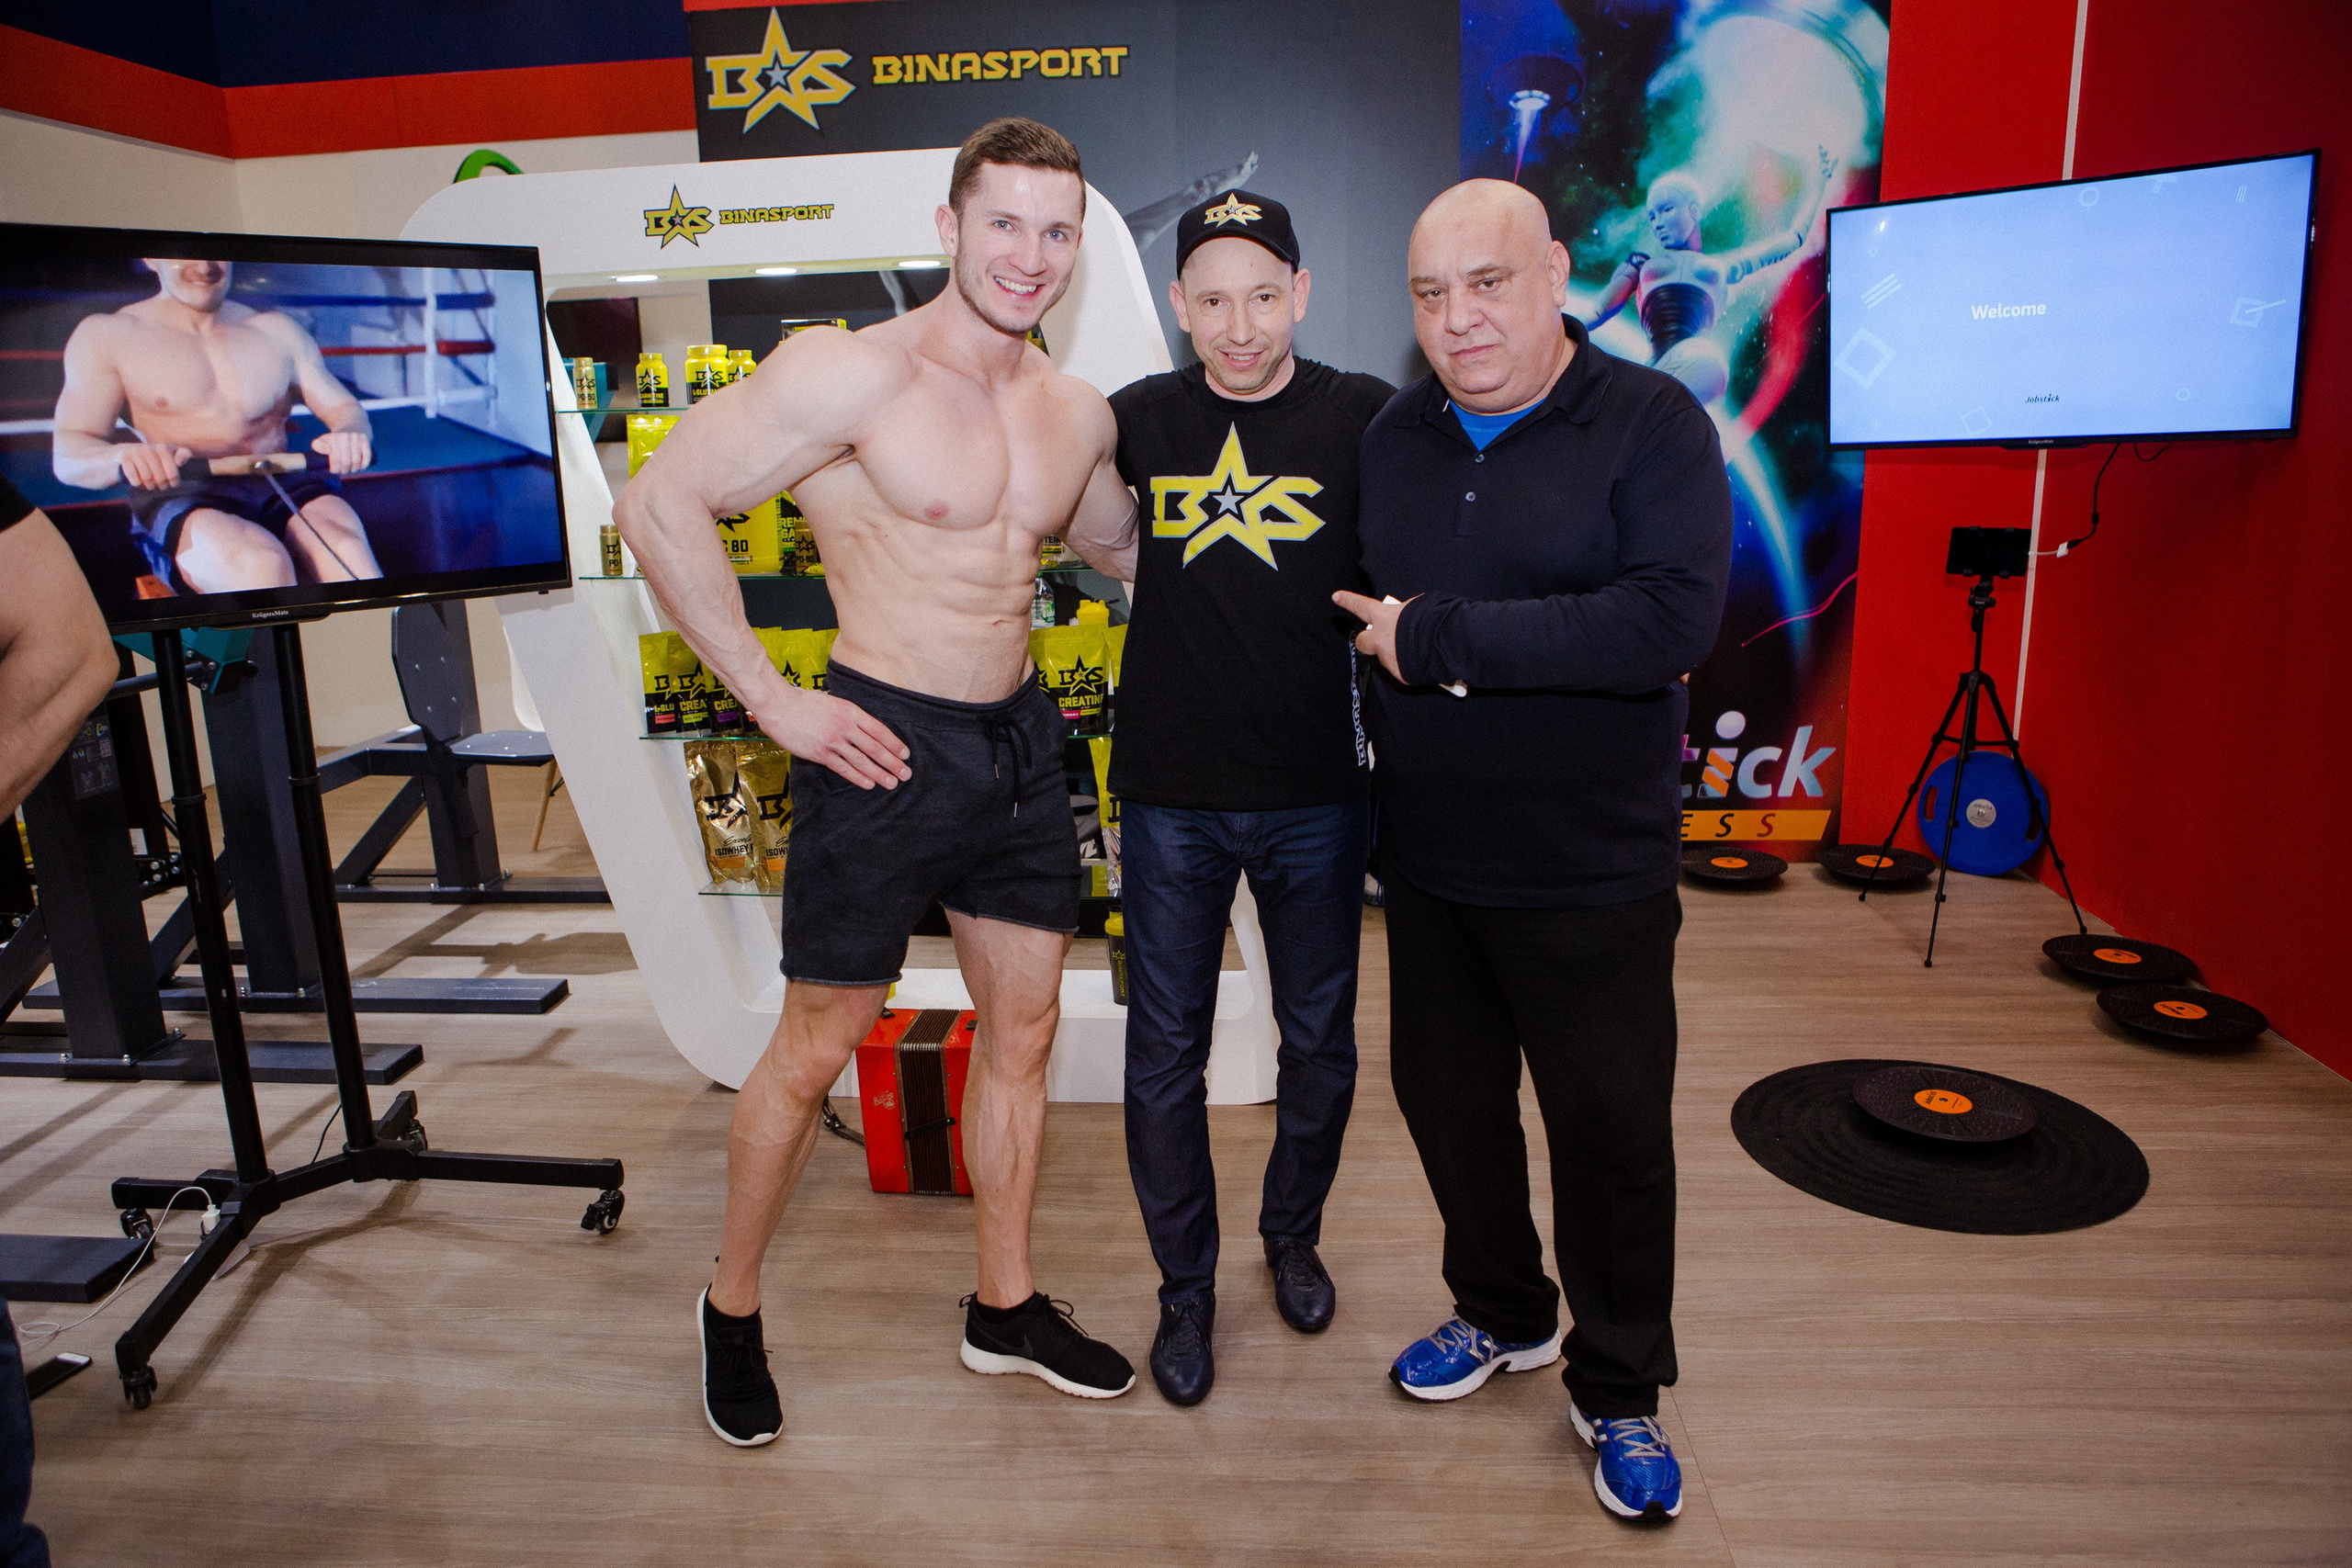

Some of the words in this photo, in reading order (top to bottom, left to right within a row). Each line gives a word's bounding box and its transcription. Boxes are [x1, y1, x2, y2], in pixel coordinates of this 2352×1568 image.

[872, 47, 1129, 85] BINASPORT
[718, 204, 834, 224] BINASPORT
[1971, 303, 2047, 320] Welcome
[2025, 393, 2060, 403] Jobstick
[731, 540, 748, 552] 80
[680, 698, 707, 711] CREA
[714, 699, 738, 711] CRE
